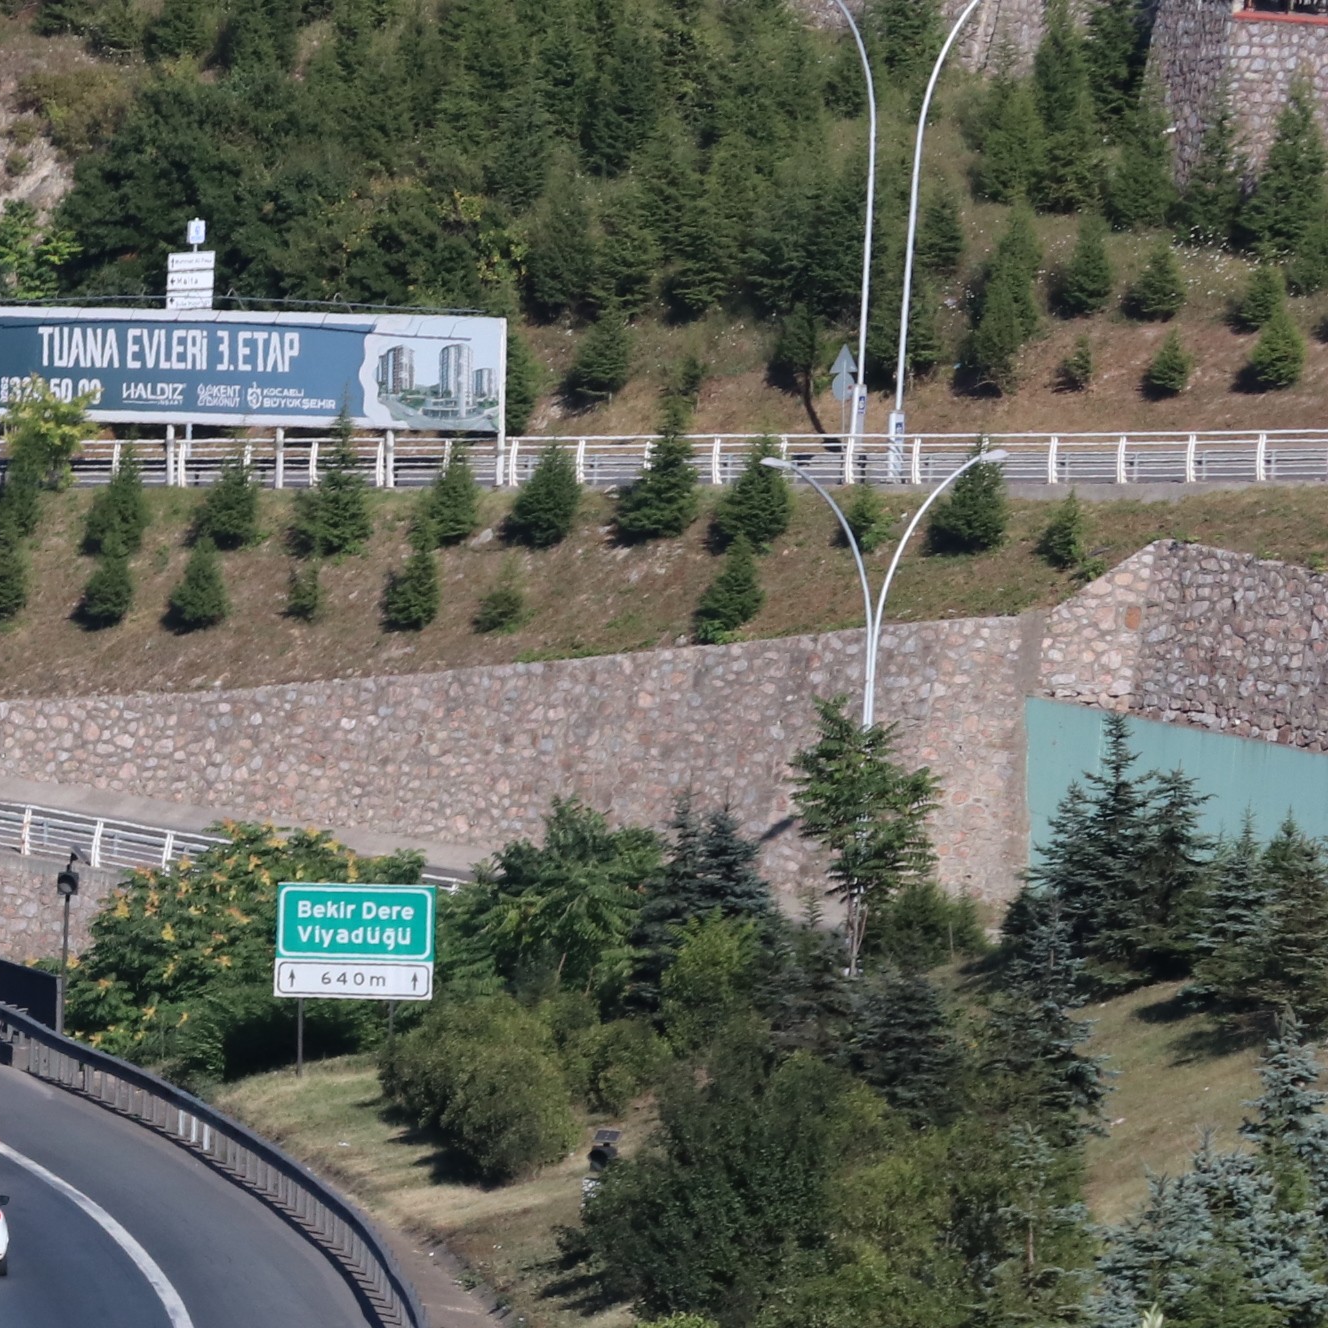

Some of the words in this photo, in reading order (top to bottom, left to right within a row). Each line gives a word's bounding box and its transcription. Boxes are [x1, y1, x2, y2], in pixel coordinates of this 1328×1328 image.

[37, 326, 120, 369] TUANA
[122, 382, 184, 400] HALDIZ
[213, 384, 241, 397] KENT
[297, 900, 356, 919] Bekir
[362, 901, 415, 920] Dere
[297, 925, 412, 951] Viyadüğü
[321, 971, 365, 986] 640
[369, 974, 386, 987] m
